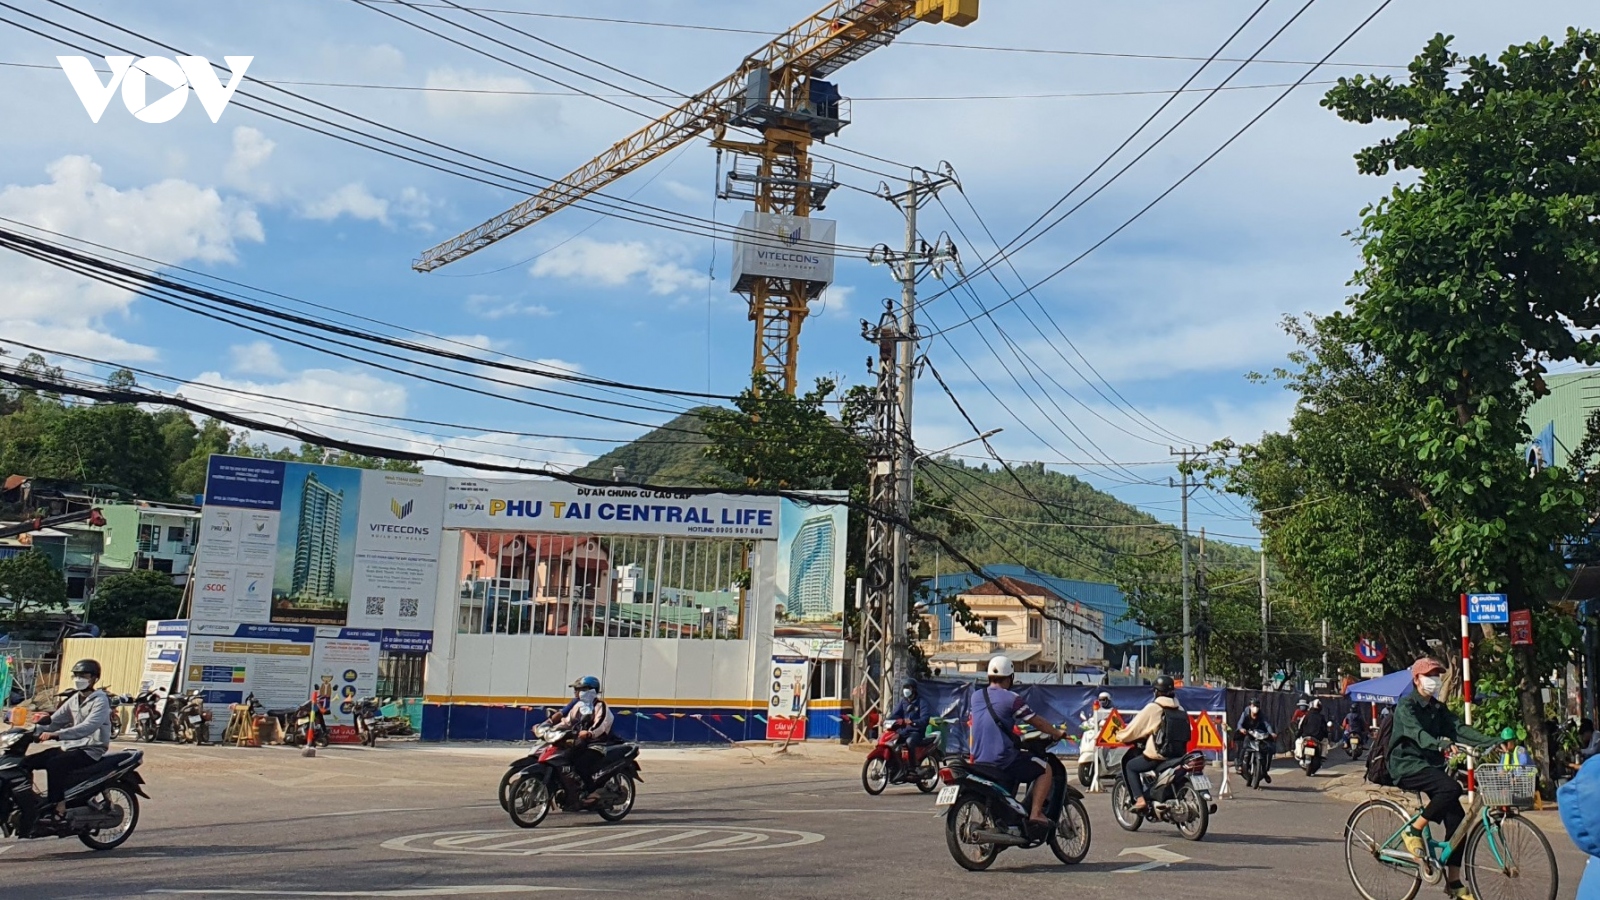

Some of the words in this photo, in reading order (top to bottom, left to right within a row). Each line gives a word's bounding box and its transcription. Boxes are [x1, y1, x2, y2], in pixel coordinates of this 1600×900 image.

[757, 250, 819, 264] VITECCONS
[607, 490, 638, 498] CHUNG
[489, 499, 542, 517] PHU
[550, 502, 591, 519] TAI
[598, 502, 714, 523] CENTRAL
[722, 508, 772, 526] LIFE
[370, 524, 429, 535] VITECCONS
[1481, 602, 1496, 612] THÁI
